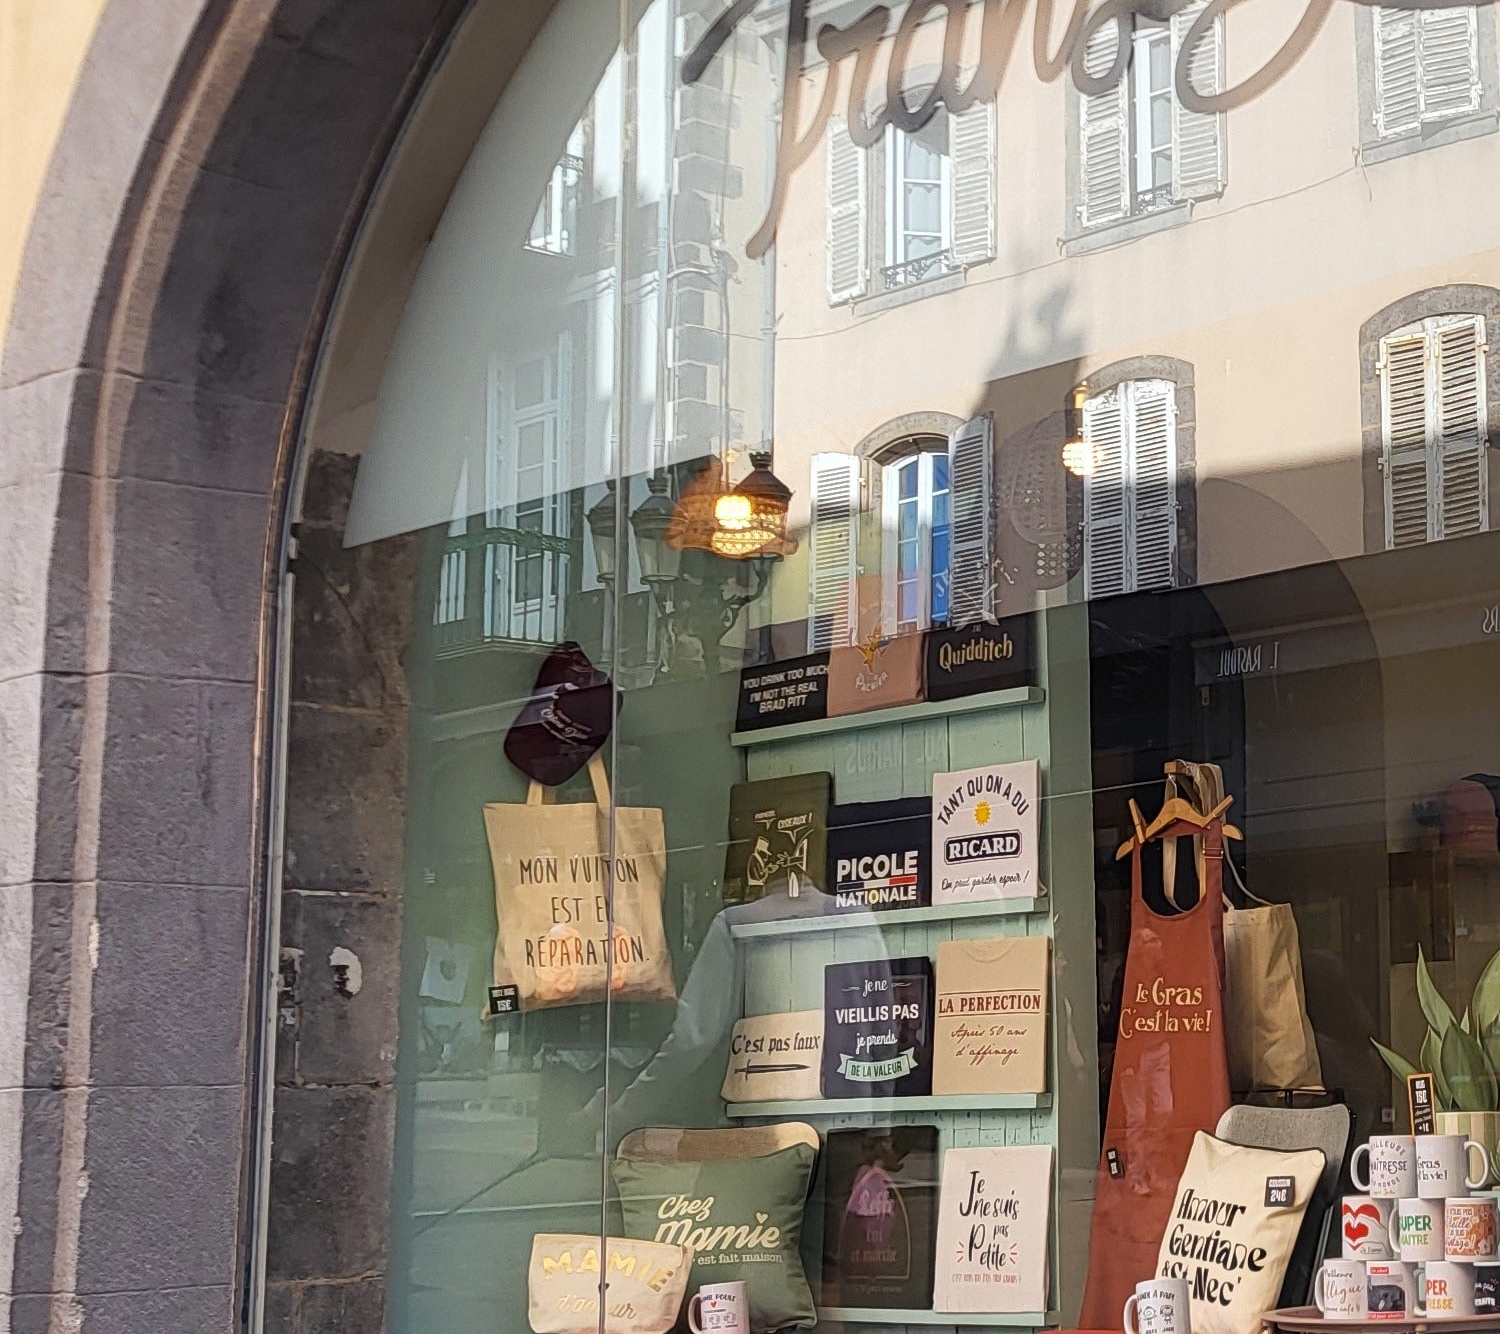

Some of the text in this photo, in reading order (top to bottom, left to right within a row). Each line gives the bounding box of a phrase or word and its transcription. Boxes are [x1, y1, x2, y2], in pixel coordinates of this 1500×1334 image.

[939, 633, 1013, 672] Quidditch
[743, 665, 829, 690] YOU DRINK TOO MUCH
[759, 695, 808, 713] BRAD PITT
[762, 688, 779, 701] NOT
[780, 685, 797, 697] THE
[797, 681, 820, 694] REAL
[937, 782, 1030, 825] TANT A DU
[948, 836, 1018, 860] RICARD
[519, 858, 558, 884] MON
[836, 850, 919, 882] PICOLE
[551, 896, 583, 923] EST
[835, 885, 917, 908] NATIONALE
[938, 993, 1041, 1014] LA PERFECTION
[1135, 977, 1203, 1005] Le Gras
[835, 1003, 919, 1024] VIEILLIS PAS
[1119, 1007, 1164, 1039] C'est
[1165, 1010, 1179, 1032] la
[855, 1028, 898, 1054] je prends
[989, 1025, 1004, 1038] 50
[1006, 1028, 1027, 1038] ans
[732, 1033, 821, 1057] C'est pas faux
[850, 1061, 903, 1078] DE LA VALEUR
[959, 1170, 985, 1218] Je
[992, 1190, 1020, 1219] suis
[657, 1195, 714, 1221] Chez
[1176, 1188, 1246, 1227] Amour
[654, 1218, 781, 1251] Mamie
[993, 1224, 1010, 1239] pas
[968, 1223, 1007, 1267] Petite
[1169, 1223, 1267, 1272] Gentiane
[542, 1249, 675, 1293] MAMIE
[697, 1252, 783, 1265] est fait maison
[1426, 1279, 1448, 1296] PER
